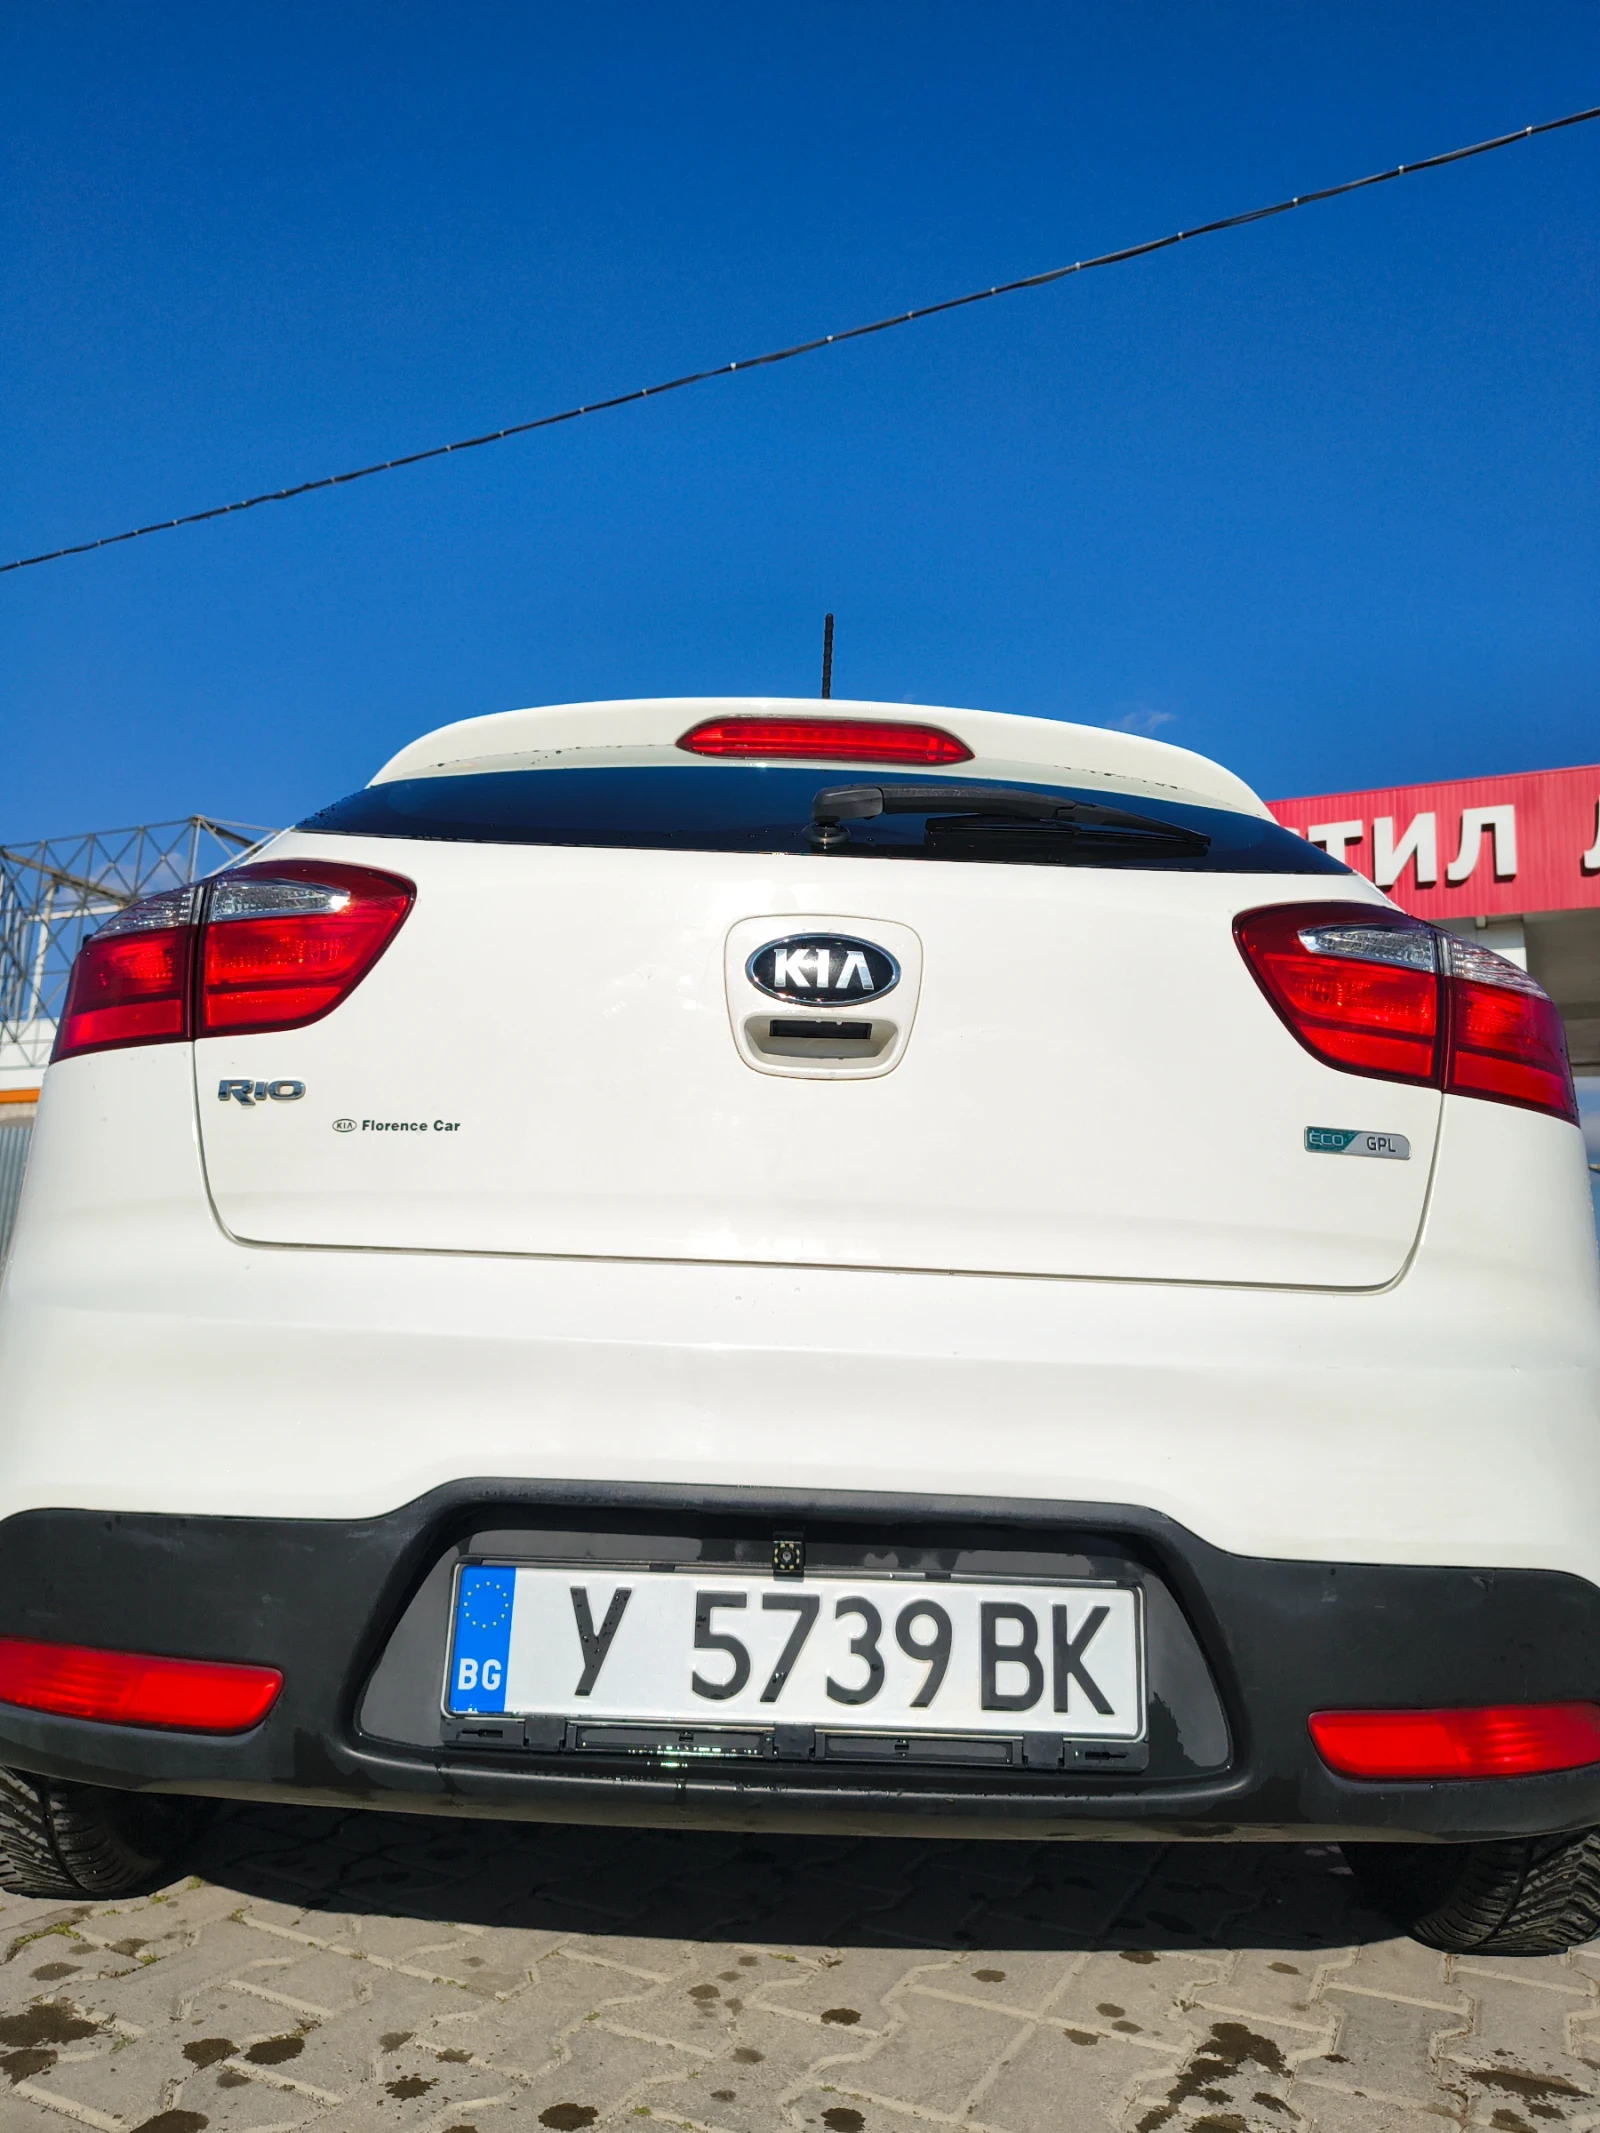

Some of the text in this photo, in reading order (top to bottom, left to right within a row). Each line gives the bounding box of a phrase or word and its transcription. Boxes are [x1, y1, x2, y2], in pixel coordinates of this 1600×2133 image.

[1284, 804, 1516, 885] ТИЛ
[773, 948, 875, 991] KIA
[217, 1078, 306, 1106] RIO
[362, 1120, 428, 1131] Florence
[434, 1120, 460, 1131] Car
[1309, 1131, 1396, 1152] ECO GPL
[458, 1659, 501, 1691] BG
[690, 1590, 953, 1709] 5739
[981, 1601, 1116, 1716] BK
